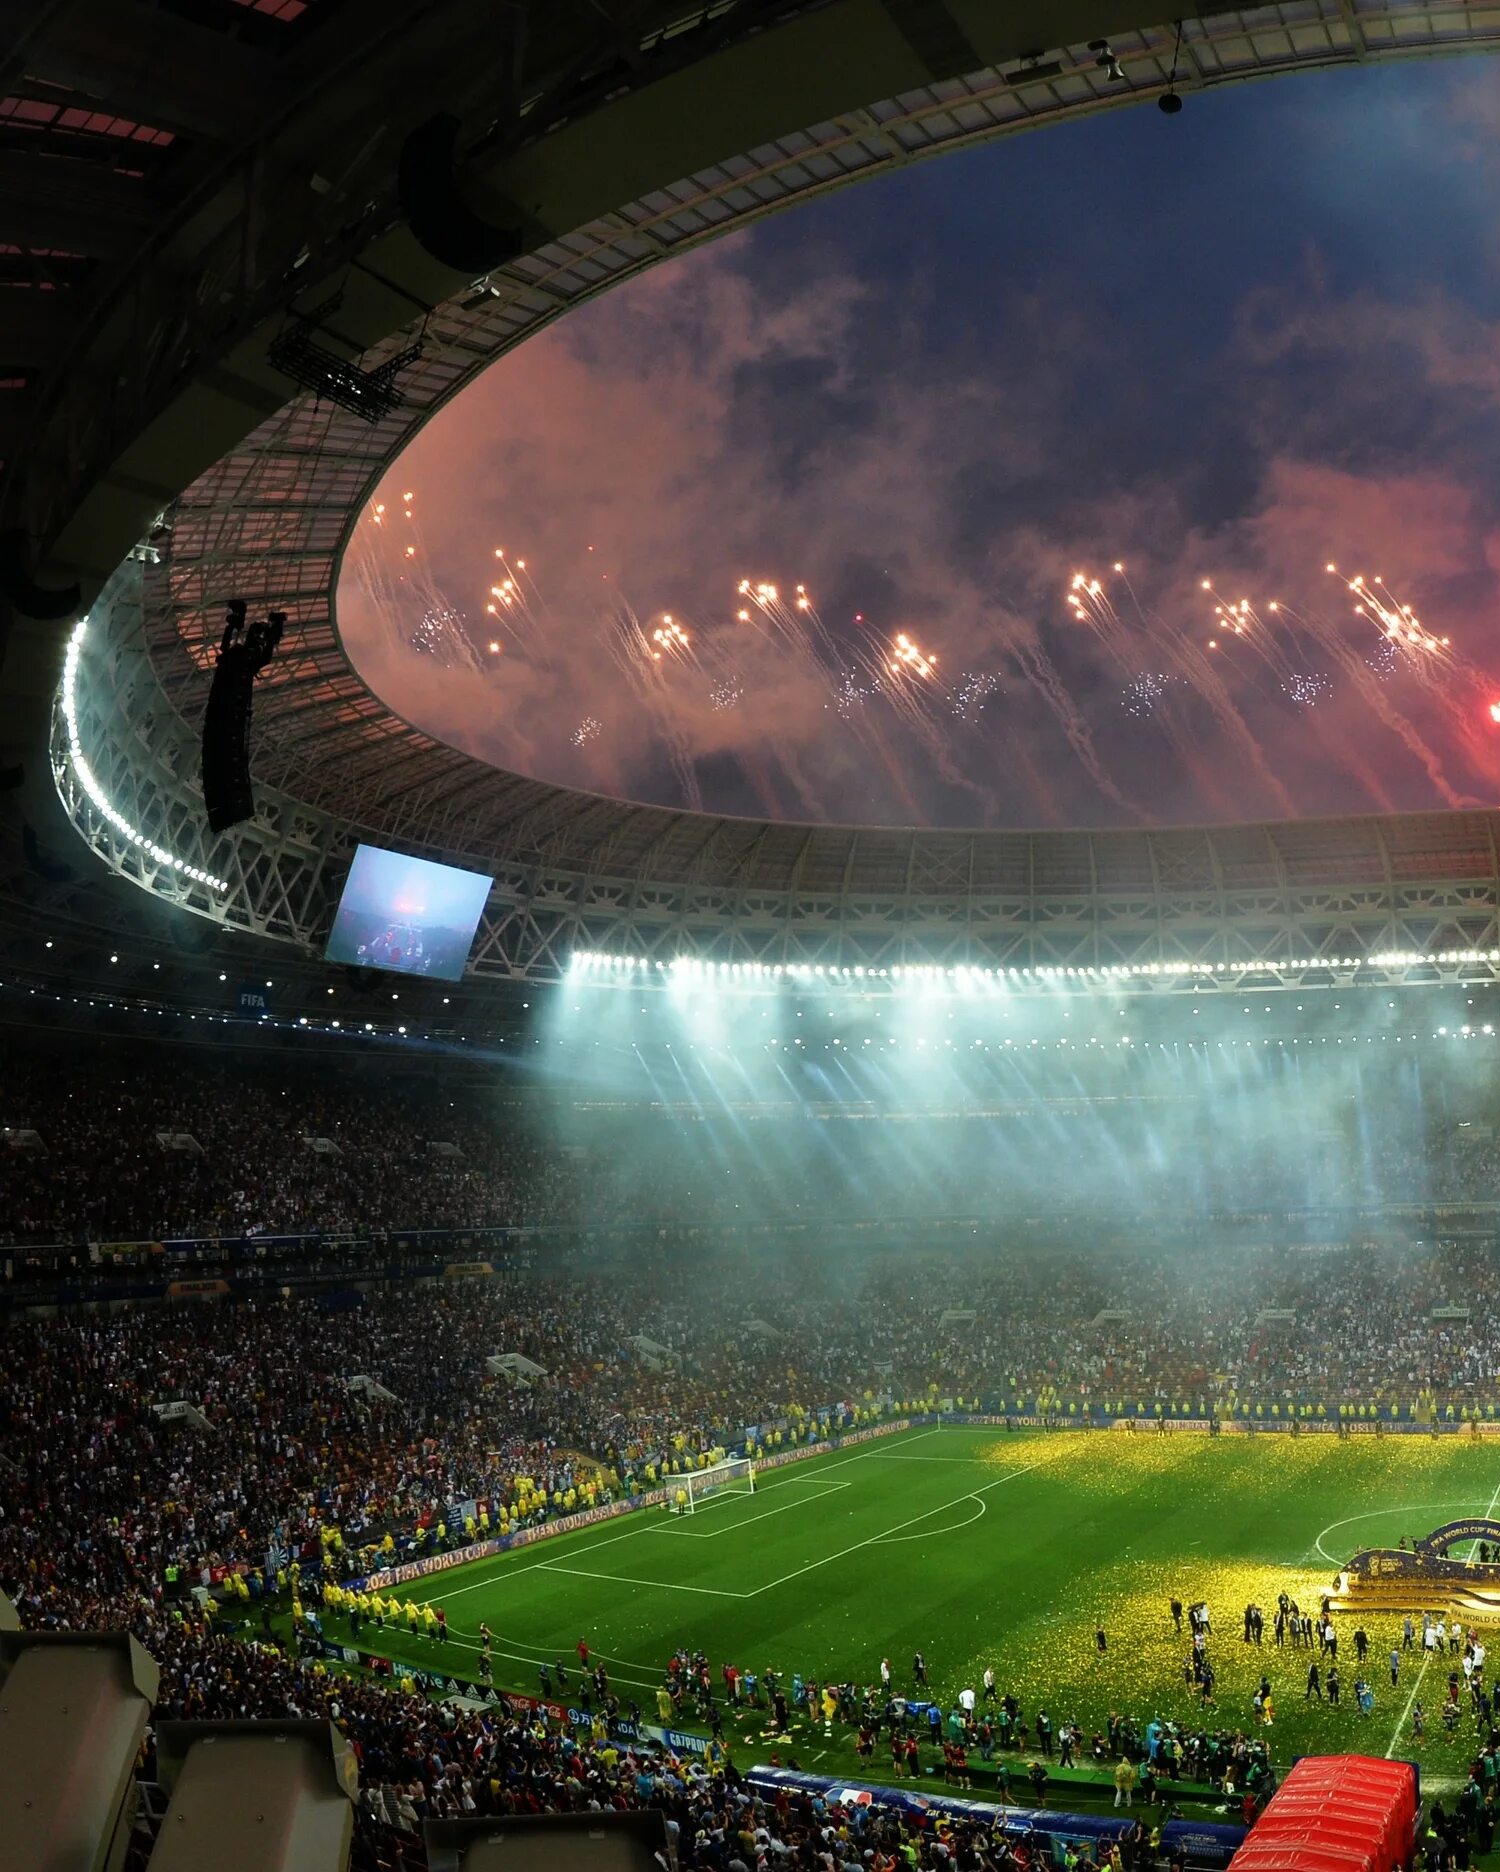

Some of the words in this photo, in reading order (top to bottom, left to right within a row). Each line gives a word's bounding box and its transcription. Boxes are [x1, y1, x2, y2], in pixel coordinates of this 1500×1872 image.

[241, 993, 265, 1007] FIFA
[1430, 1536, 1444, 1548] FIFA
[1443, 1527, 1469, 1540] WORLD
[364, 1570, 392, 1592] 2022
[420, 1551, 464, 1575] WORLD
[465, 1543, 488, 1561] CUP
[1463, 1613, 1491, 1624] WORLD
